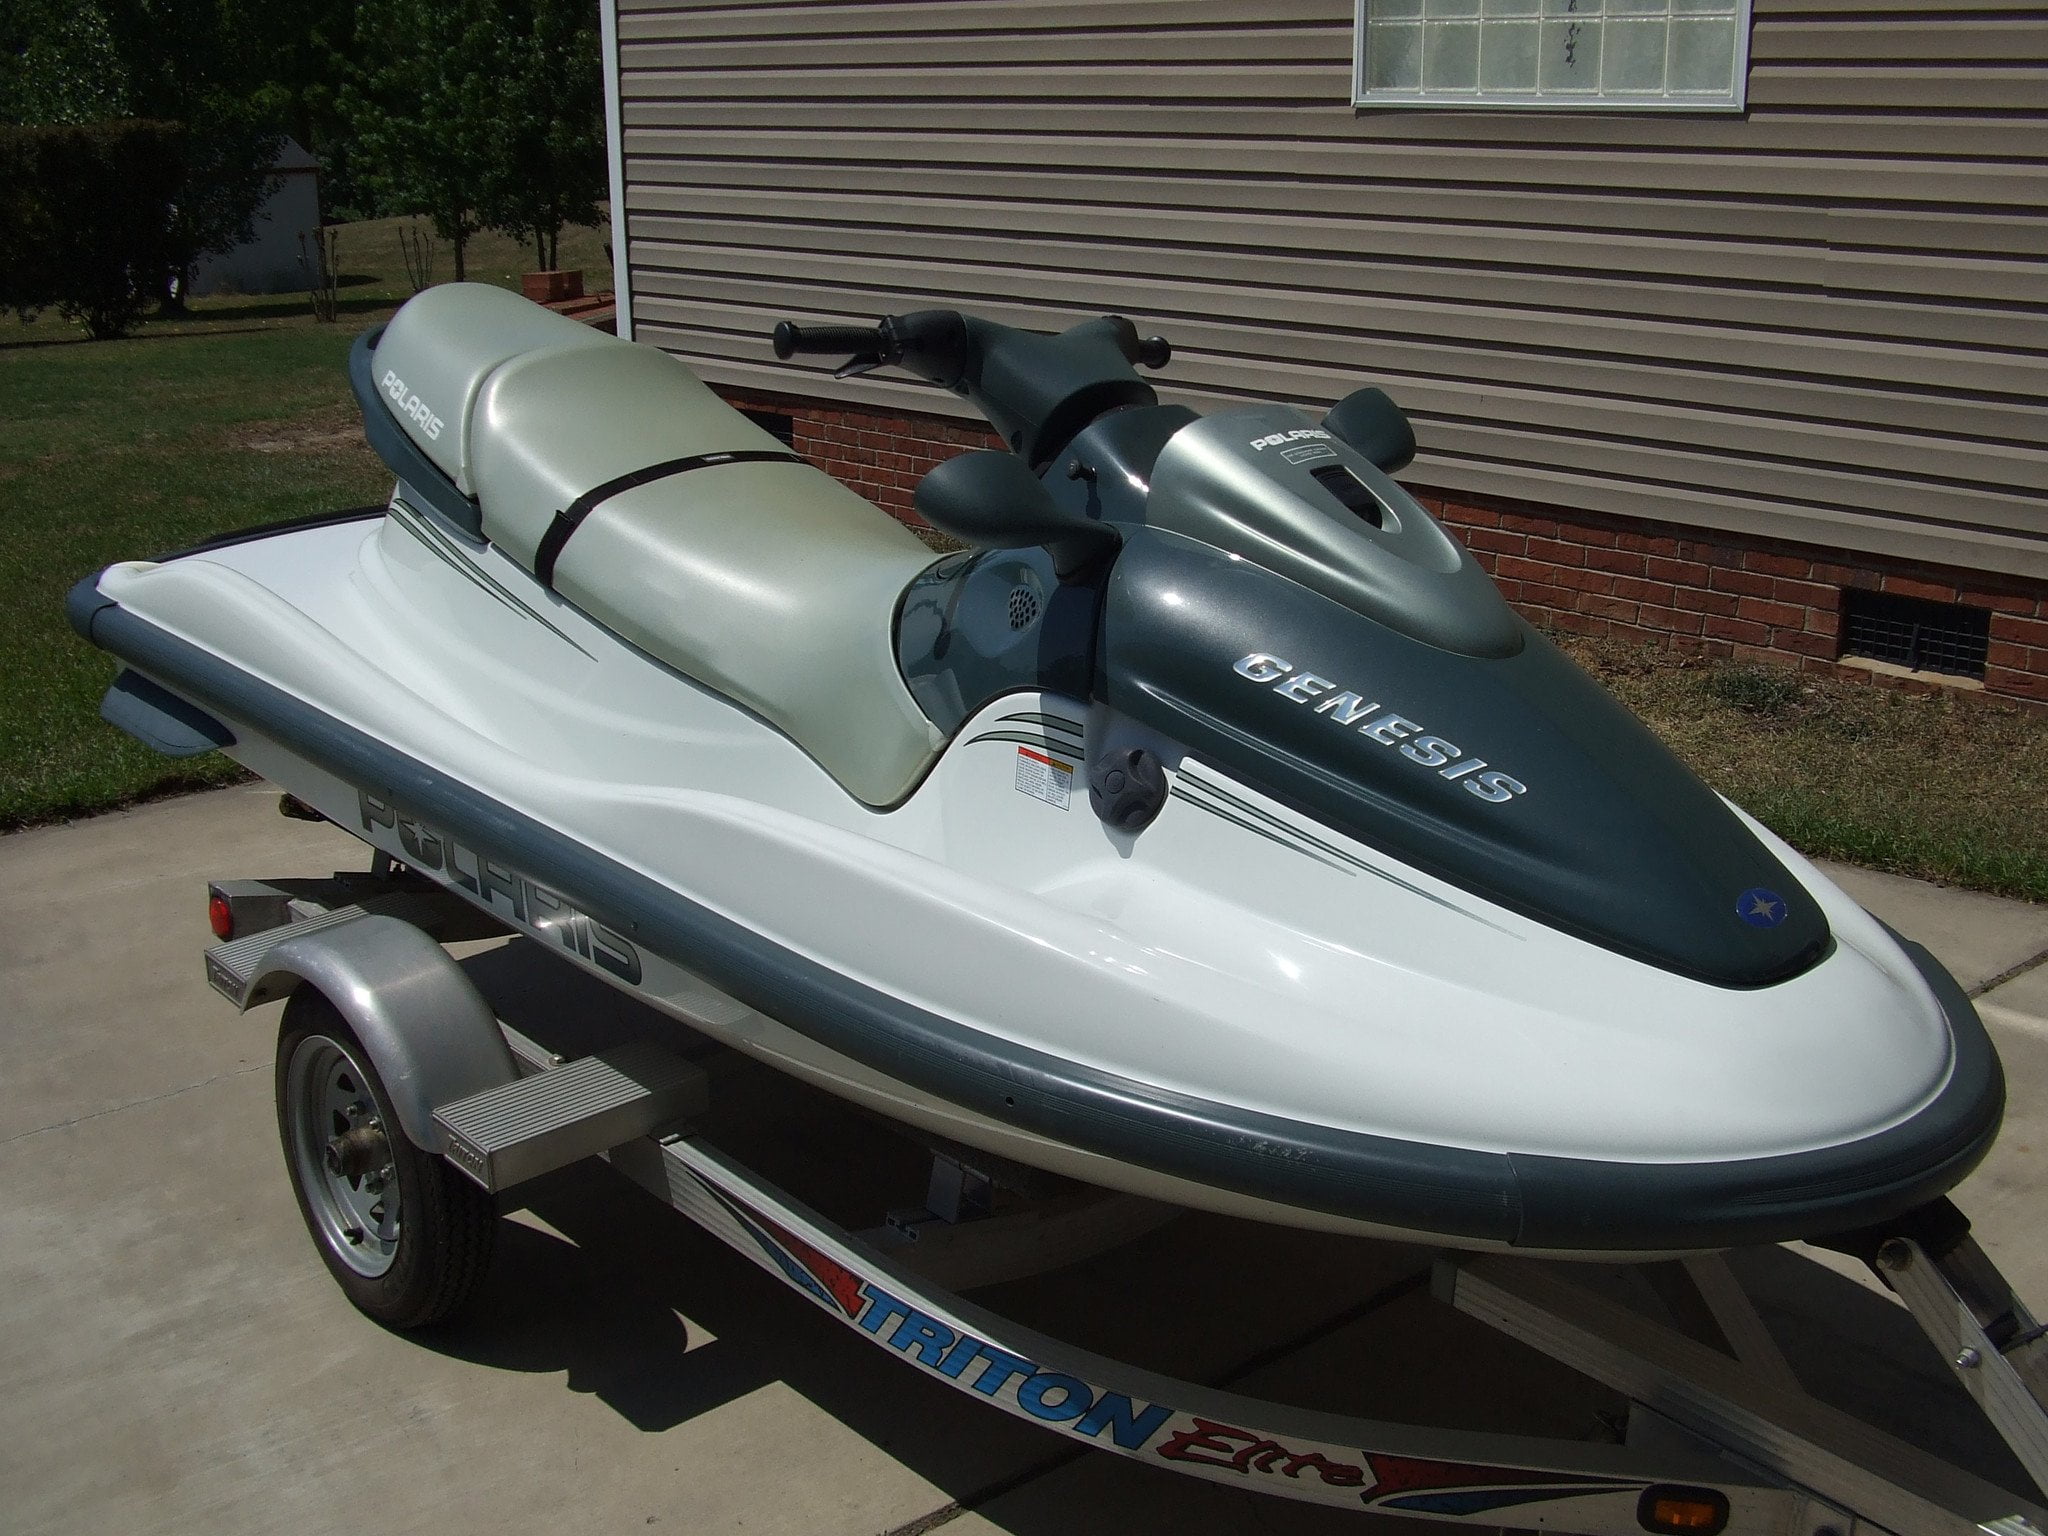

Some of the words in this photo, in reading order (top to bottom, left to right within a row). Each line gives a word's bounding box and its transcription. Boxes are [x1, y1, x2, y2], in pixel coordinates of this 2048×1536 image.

[382, 370, 444, 440] POLARIS
[1250, 429, 1331, 451] POLARIS
[1233, 653, 1527, 803] GENESIS
[859, 1284, 1175, 1450] TRITON
